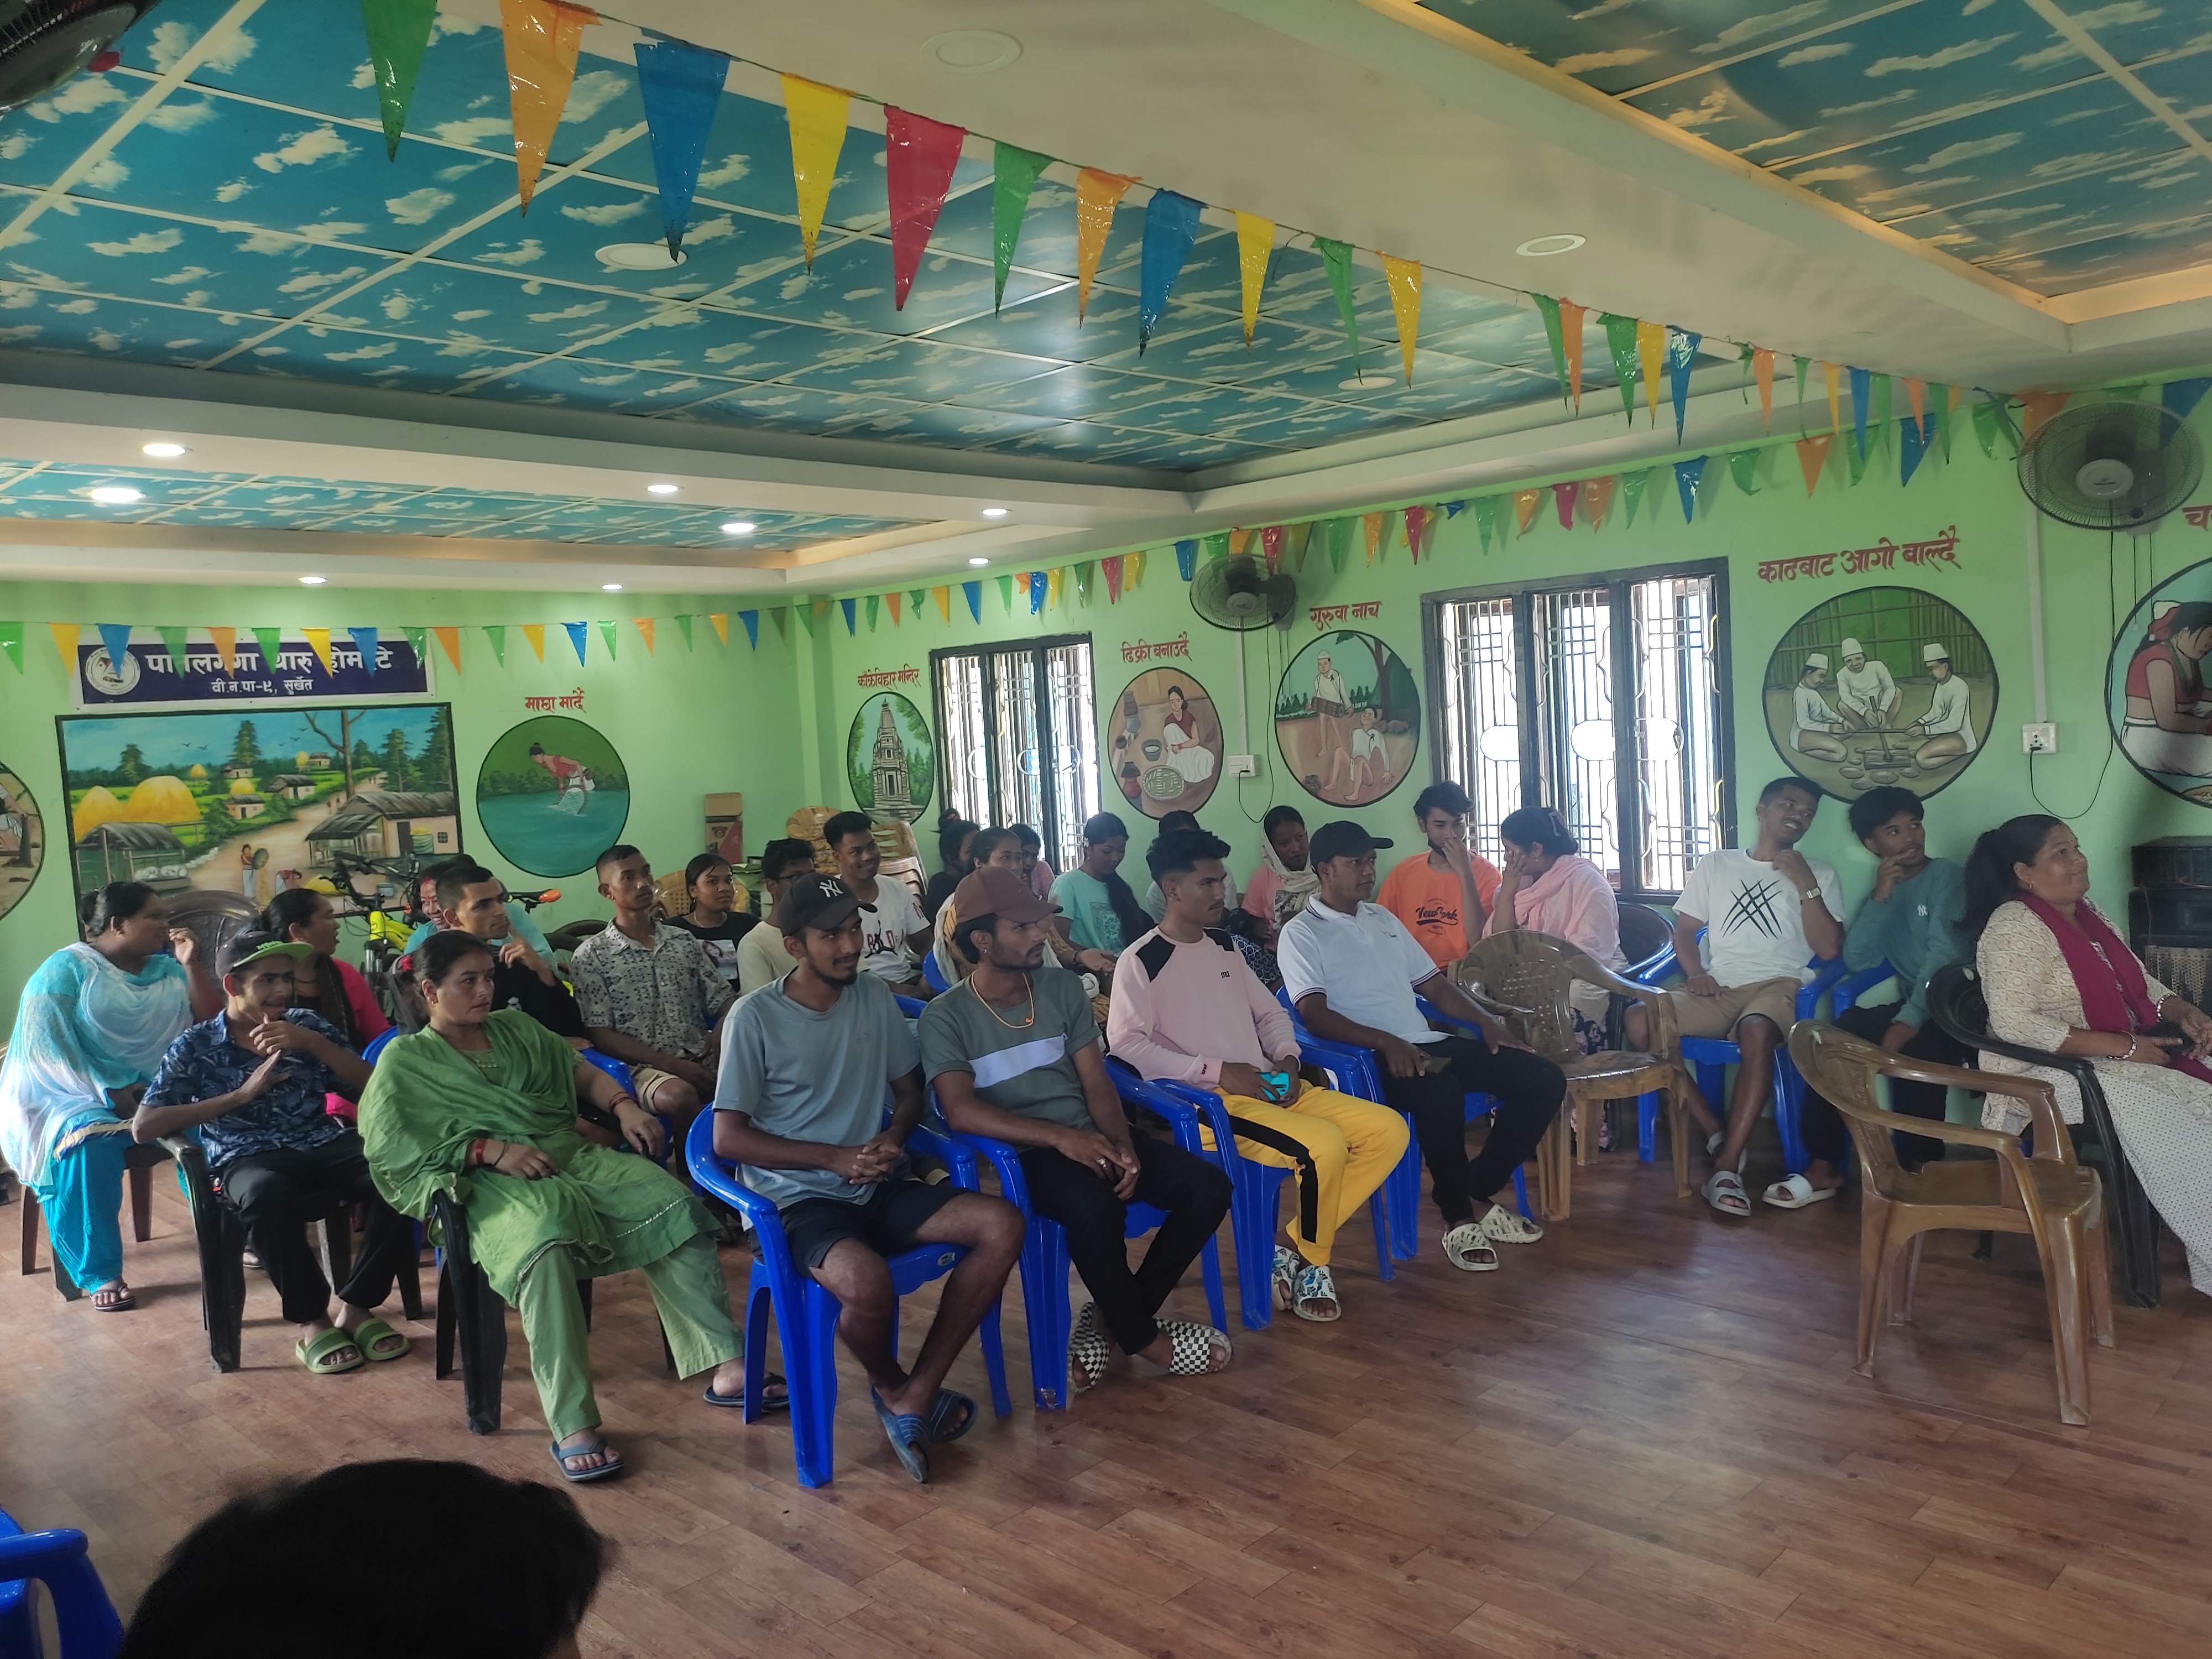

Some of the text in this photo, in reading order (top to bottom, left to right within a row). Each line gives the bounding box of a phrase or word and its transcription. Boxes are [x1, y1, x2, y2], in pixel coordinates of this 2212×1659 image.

[1758, 525, 1962, 583] काठबाट आगो बाल्दै
[1351, 601, 1382, 620] नाच
[1120, 638, 1152, 664] ढिक्री
[283, 675, 314, 695] सुर्खेत
[898, 663, 921, 688] मन्दिर
[525, 697, 557, 713] माछा
[819, 879, 844, 898] NY
